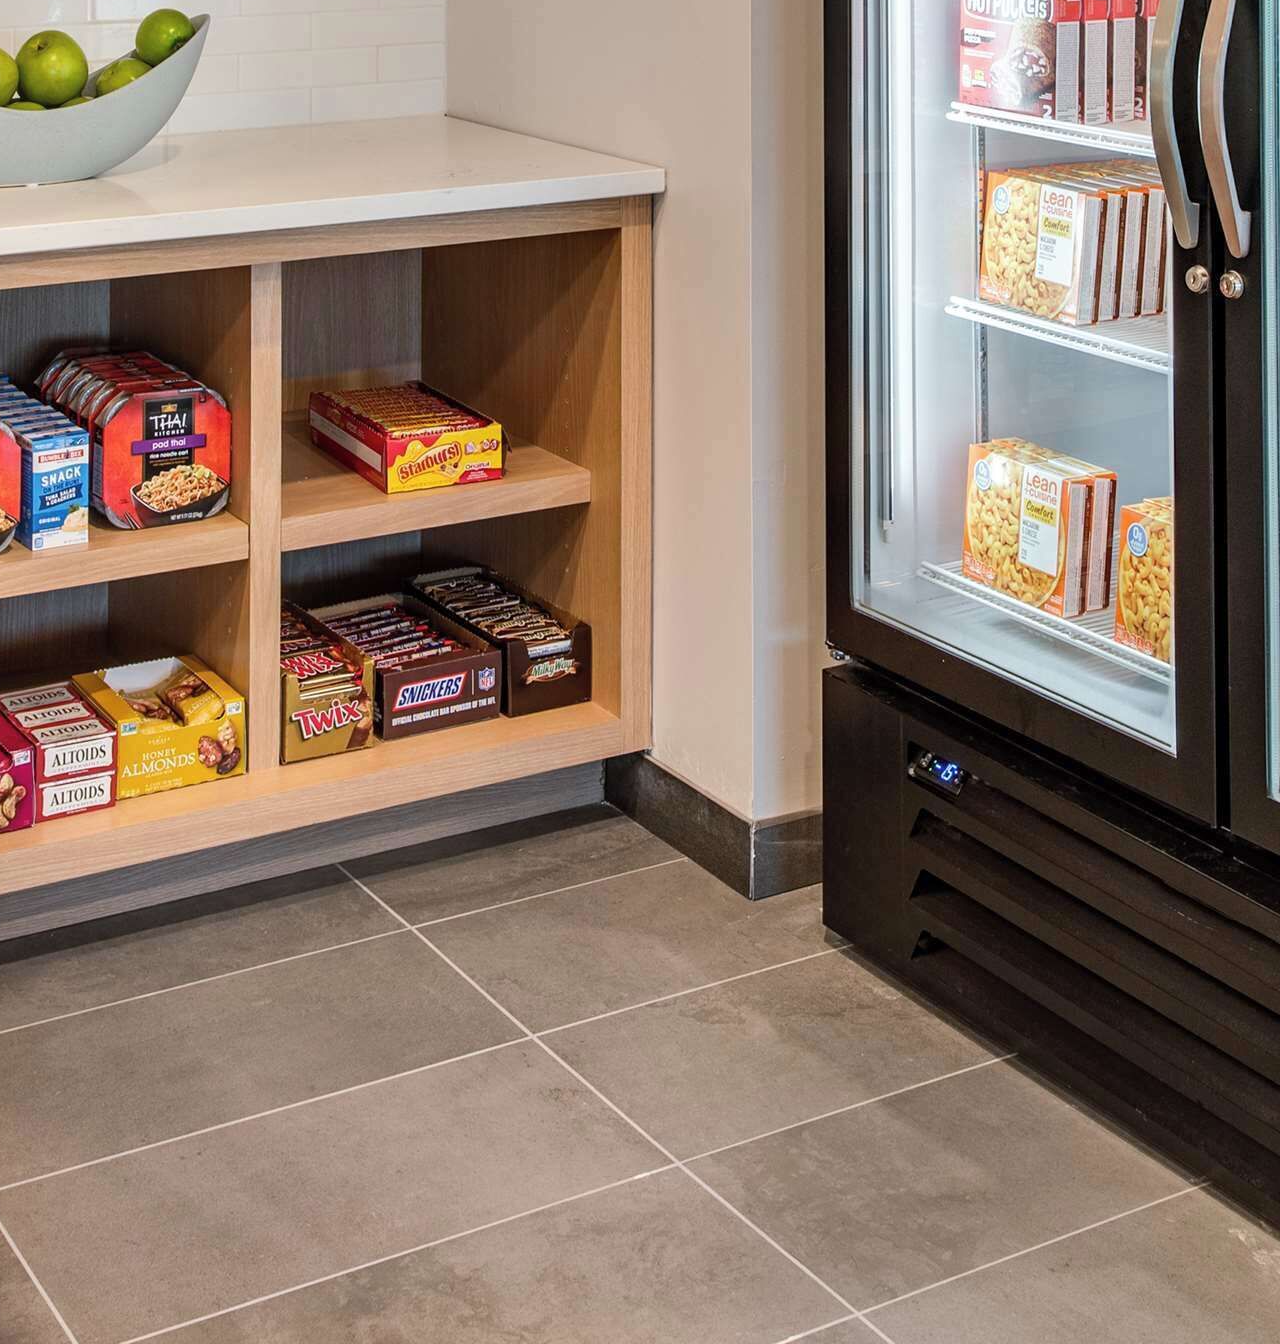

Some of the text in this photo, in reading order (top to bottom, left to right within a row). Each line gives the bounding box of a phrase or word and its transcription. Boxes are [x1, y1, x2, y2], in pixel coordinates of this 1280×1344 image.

[1043, 189, 1073, 210] Lean
[1043, 216, 1070, 233] Comfort
[149, 413, 187, 431] THAI
[152, 438, 186, 450] pad thai
[399, 443, 460, 480] Starburst
[41, 466, 81, 487] SNACK
[1026, 472, 1058, 496] Lean
[1026, 500, 1054, 520] Comfort
[9, 689, 66, 707] ALTOIDS
[398, 676, 462, 707] SNICKERS
[24, 706, 81, 722] ALTOIDS
[292, 699, 363, 739] Twix
[40, 722, 98, 738] ALTOIDS
[52, 744, 107, 768] ALTOIDS
[121, 752, 197, 778] ALMONDS
[142, 748, 177, 761] HONEY
[50, 783, 105, 807] ALTOIDS
